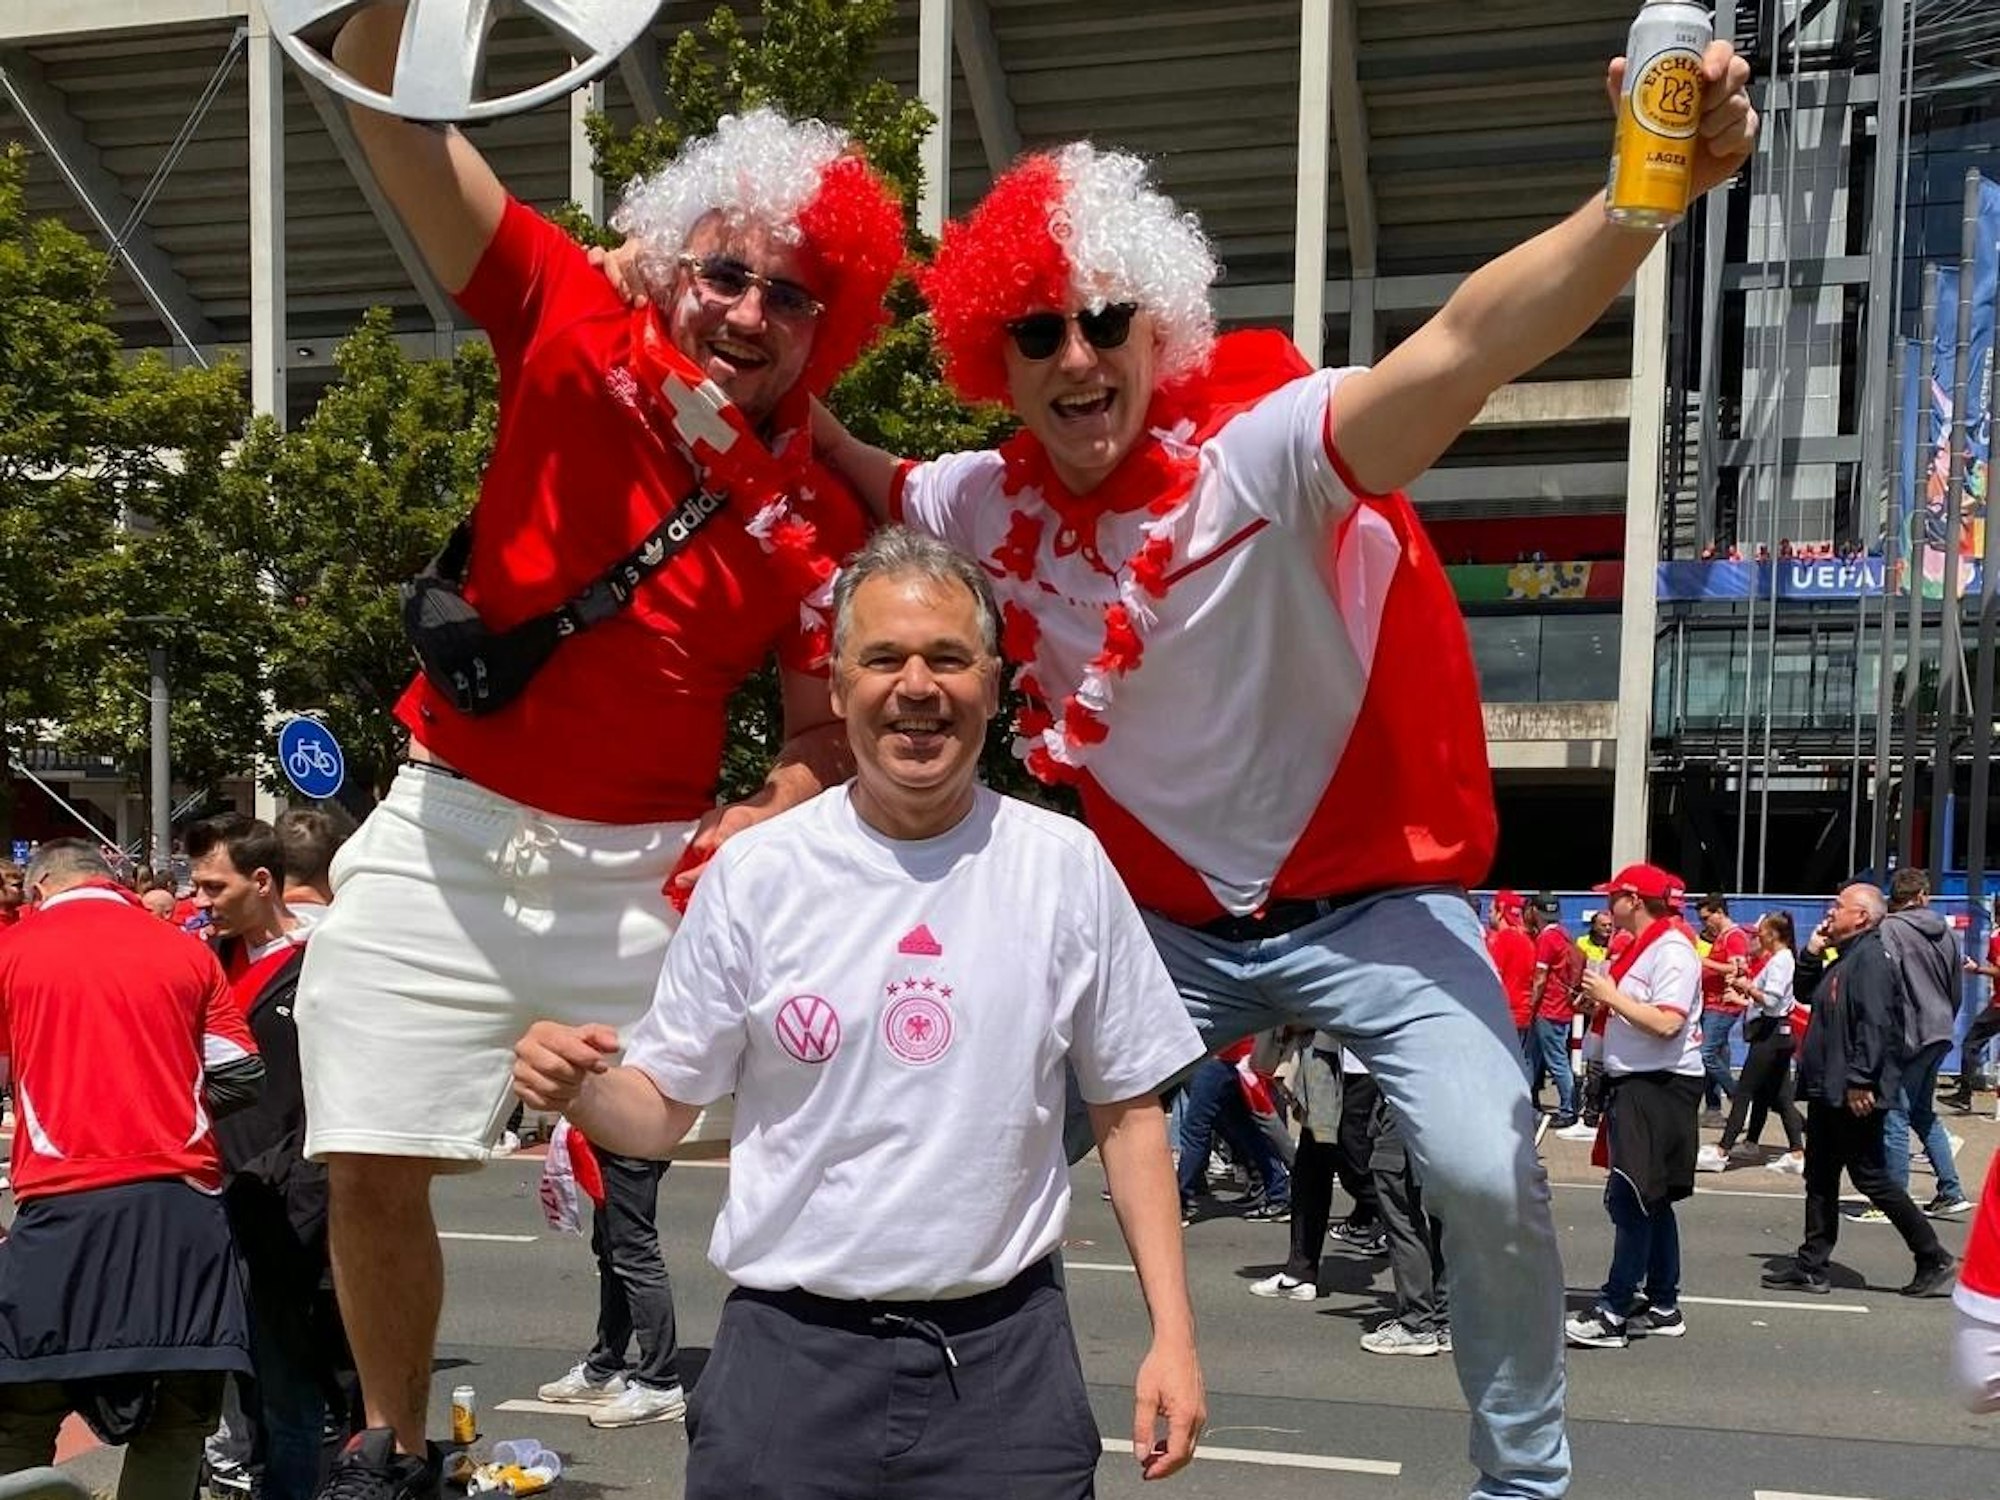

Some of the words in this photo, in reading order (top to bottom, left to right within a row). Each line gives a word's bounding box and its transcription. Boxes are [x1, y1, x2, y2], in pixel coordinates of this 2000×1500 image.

[1646, 152, 1687, 166] LAGER
[1792, 564, 1876, 589] UEFA
[776, 995, 840, 1063] VW
